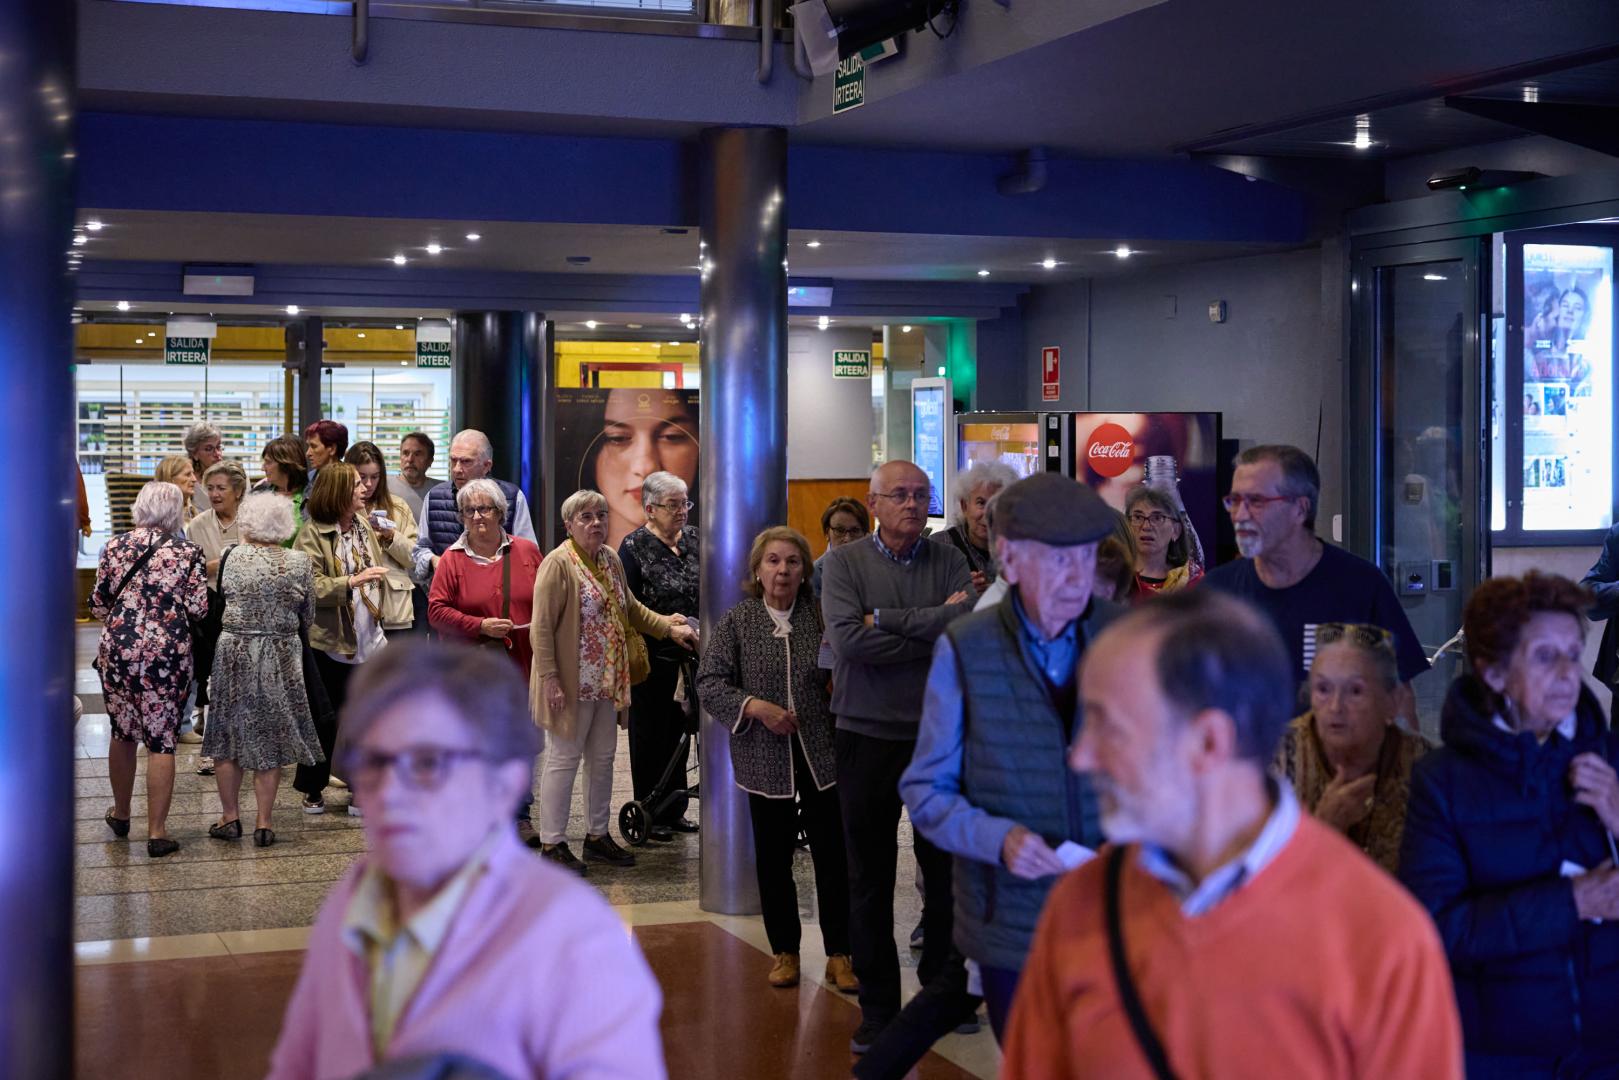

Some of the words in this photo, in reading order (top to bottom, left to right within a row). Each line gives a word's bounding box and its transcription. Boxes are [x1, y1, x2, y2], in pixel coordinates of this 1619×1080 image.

[838, 55, 862, 78] SALIDA
[835, 80, 863, 105] IRTEERA
[170, 337, 204, 348] SALIDA
[167, 351, 207, 363] IRTEERA
[418, 355, 451, 366] IRTEER
[838, 353, 865, 362] SALIDA
[835, 366, 867, 376] IRTEERA
[1088, 441, 1133, 458] Coca-Cola
